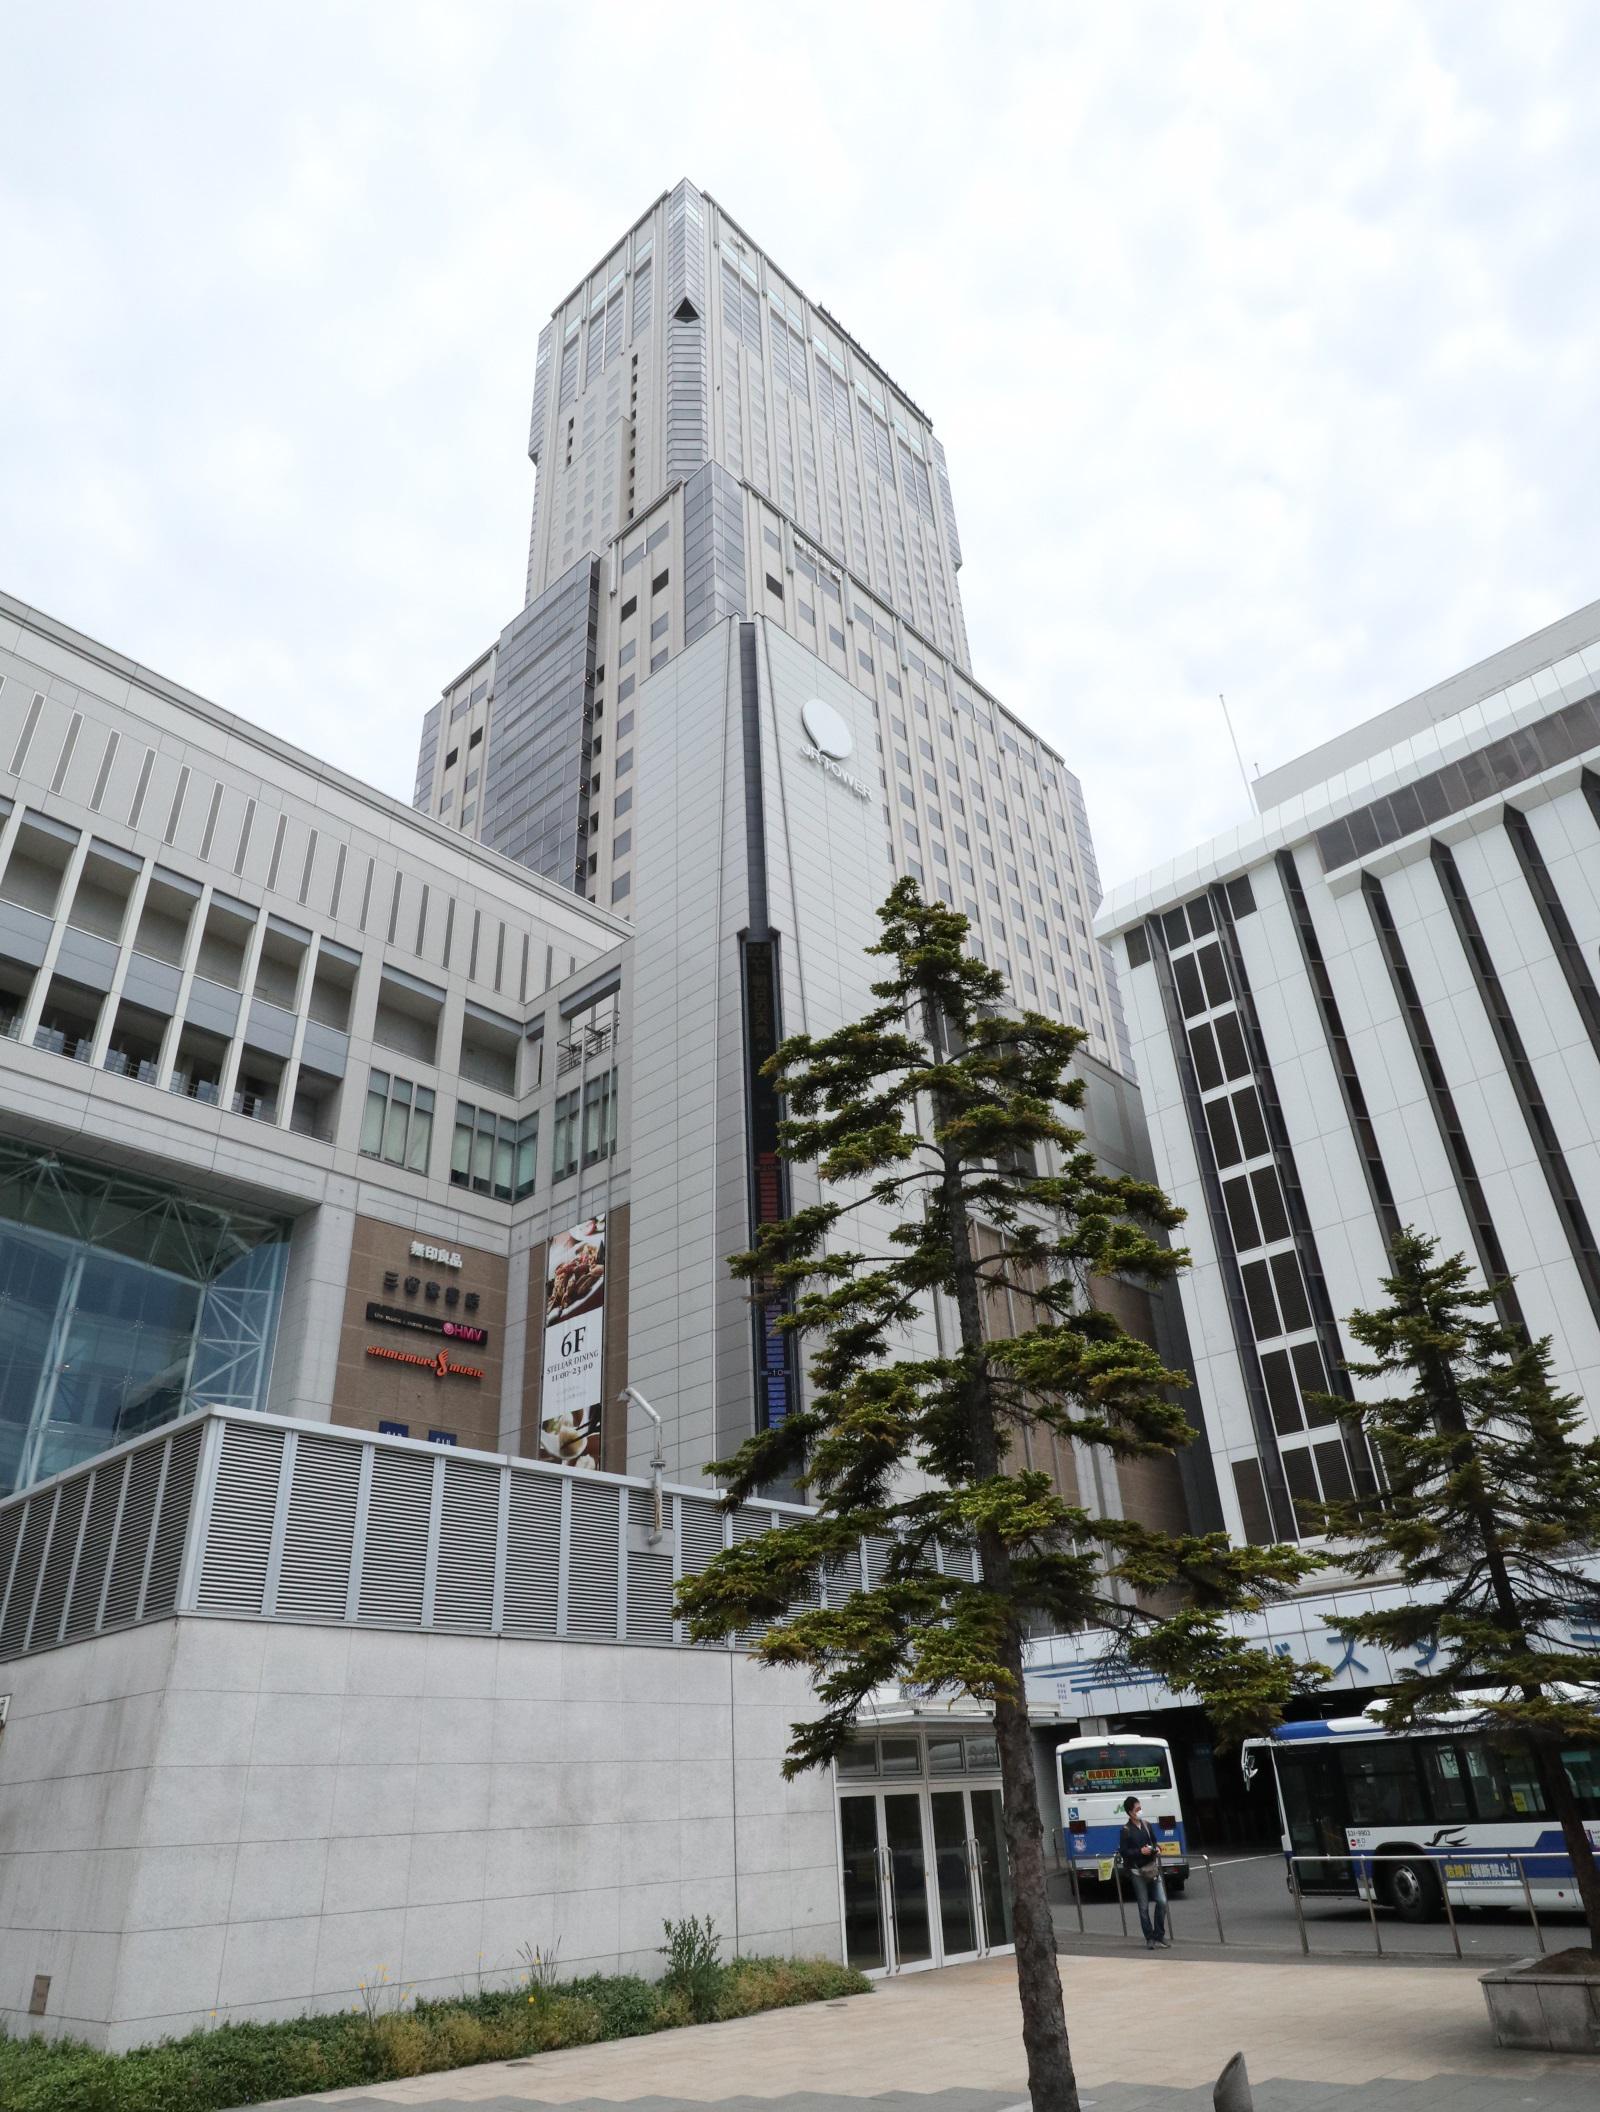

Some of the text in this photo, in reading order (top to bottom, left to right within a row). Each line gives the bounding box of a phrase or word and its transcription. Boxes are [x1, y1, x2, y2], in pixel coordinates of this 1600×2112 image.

[410, 1241, 463, 1268] 無印良品
[454, 1324, 482, 1341] HMV
[561, 1326, 586, 1357] 6F
[546, 1350, 599, 1374] STELLAR DINING
